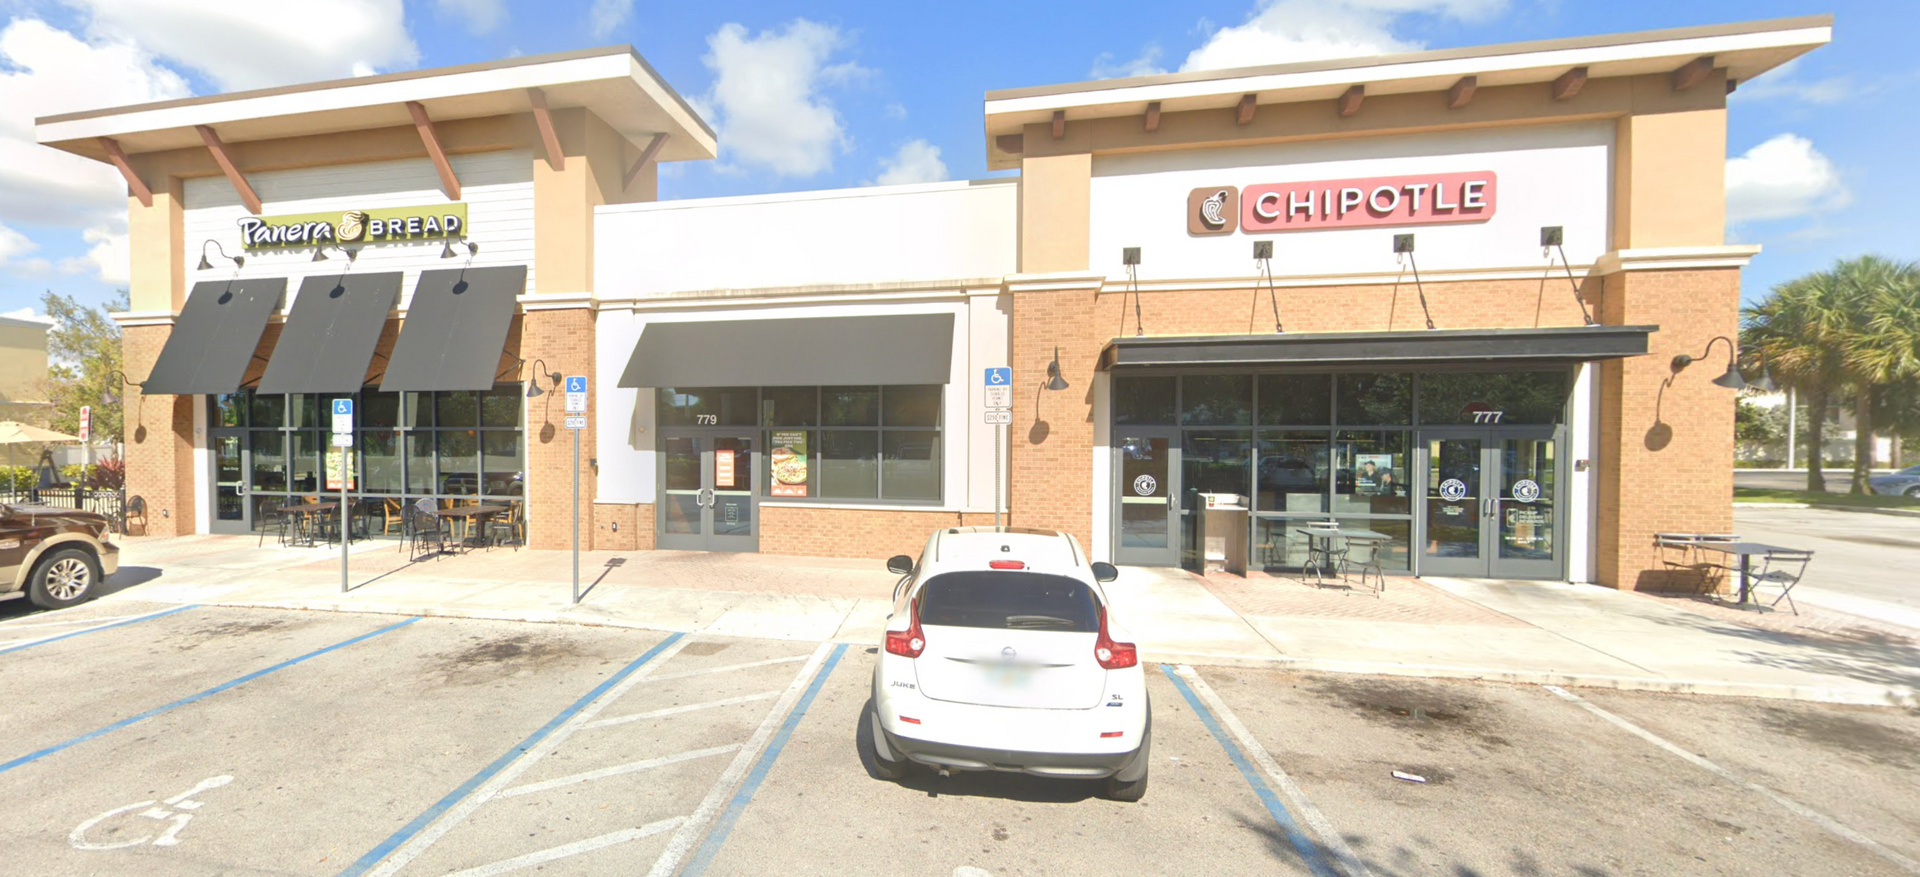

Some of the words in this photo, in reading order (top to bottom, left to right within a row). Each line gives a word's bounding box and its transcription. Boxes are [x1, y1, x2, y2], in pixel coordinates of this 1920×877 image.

[1255, 180, 1488, 218] CHIPOTLE
[237, 217, 332, 245] Panera
[369, 215, 460, 236] BREAD
[696, 414, 717, 425] 779
[1472, 411, 1503, 423] 777
[890, 681, 916, 690] JUKE
